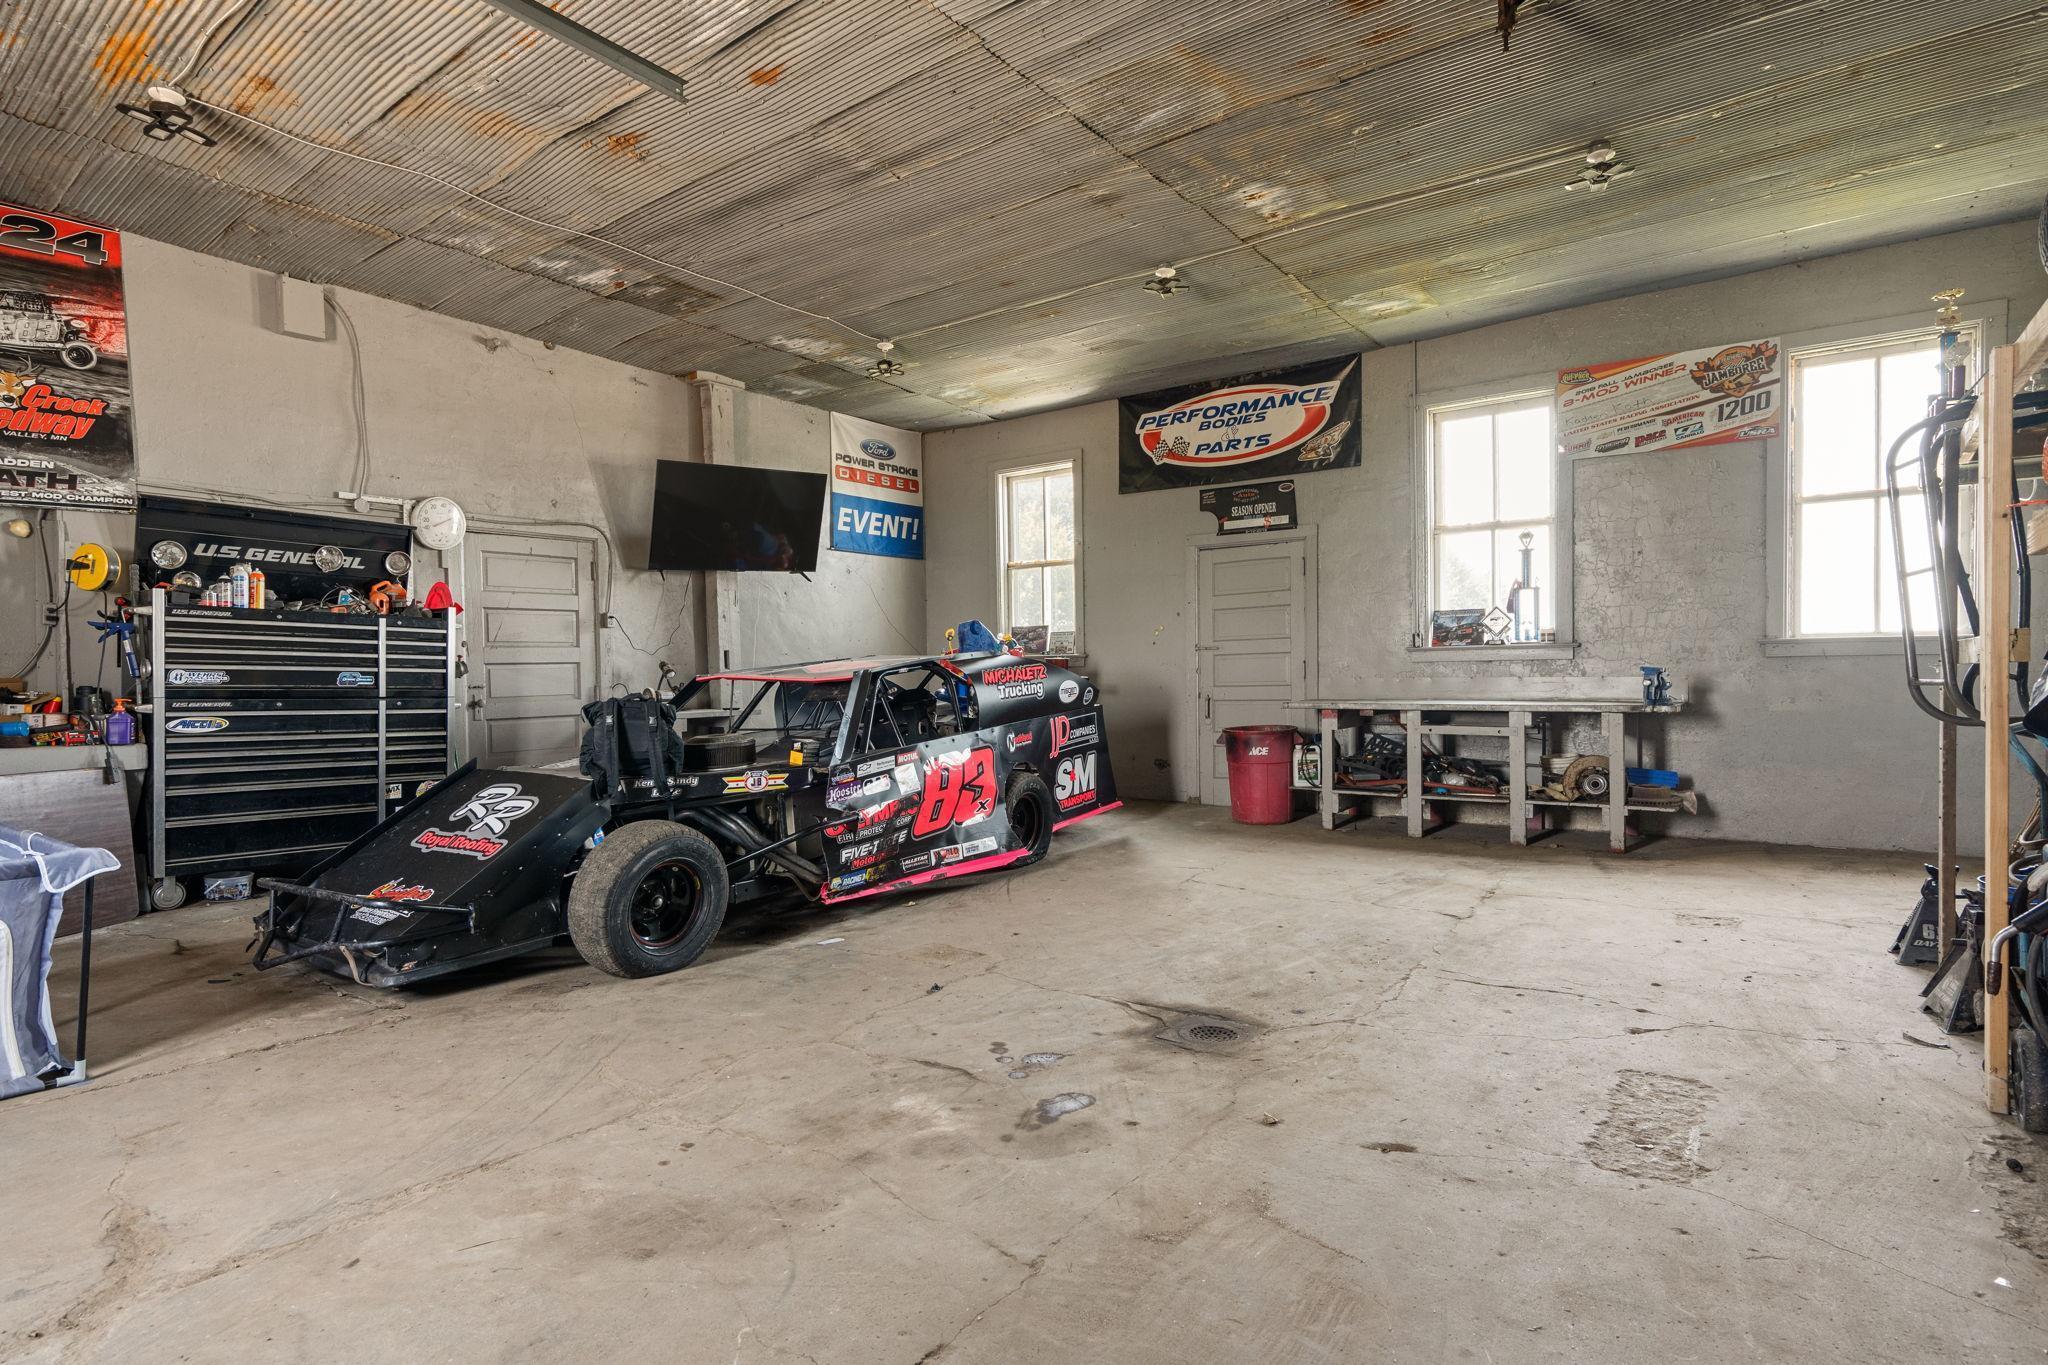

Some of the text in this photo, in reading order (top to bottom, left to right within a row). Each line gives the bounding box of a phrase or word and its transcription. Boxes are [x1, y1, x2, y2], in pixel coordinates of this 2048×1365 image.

[0, 213, 109, 265] 24
[1598, 379, 1619, 389] FALL
[1623, 361, 1675, 381] JAMBOREE
[1624, 363, 1688, 389] WINNER
[1704, 356, 1766, 387] JAMBOREE
[22, 385, 108, 416] Creek
[1139, 386, 1335, 430] PERFORMANCE
[1717, 390, 1772, 422] 1200
[1198, 411, 1267, 431] BODIES
[1563, 425, 1590, 437] UNITED
[1590, 418, 1618, 430] STATES
[1619, 408, 1648, 420] RACING
[1649, 394, 1700, 412] ASSOCIATION
[1663, 411, 1706, 427] AMERICAN
[1221, 424, 1239, 442] &
[868, 442, 889, 456] Ford
[1194, 433, 1273, 456] PARTS
[835, 453, 919, 478] POWER STROKE
[839, 467, 917, 491] DIESEL
[31, 491, 62, 500] MOD
[66, 494, 133, 505] CHAMPION
[1231, 502, 1277, 517] SEASON OPENER
[837, 507, 920, 541] EVENT!
[193, 543, 367, 570] U.S. GENEAL
[983, 664, 1048, 686] MICHALETZ
[998, 681, 1045, 700] Trucking
[1069, 724, 1096, 739] COMPANIES
[898, 752, 919, 763] MOTUL
[1249, 746, 1269, 756] ACE
[828, 783, 863, 803] Hoosier
[1059, 793, 1097, 811] TRANSPORT
[418, 831, 504, 856] Royal Roofing
[837, 833, 855, 844] FIR
[905, 854, 929, 865] ALLSTAR
